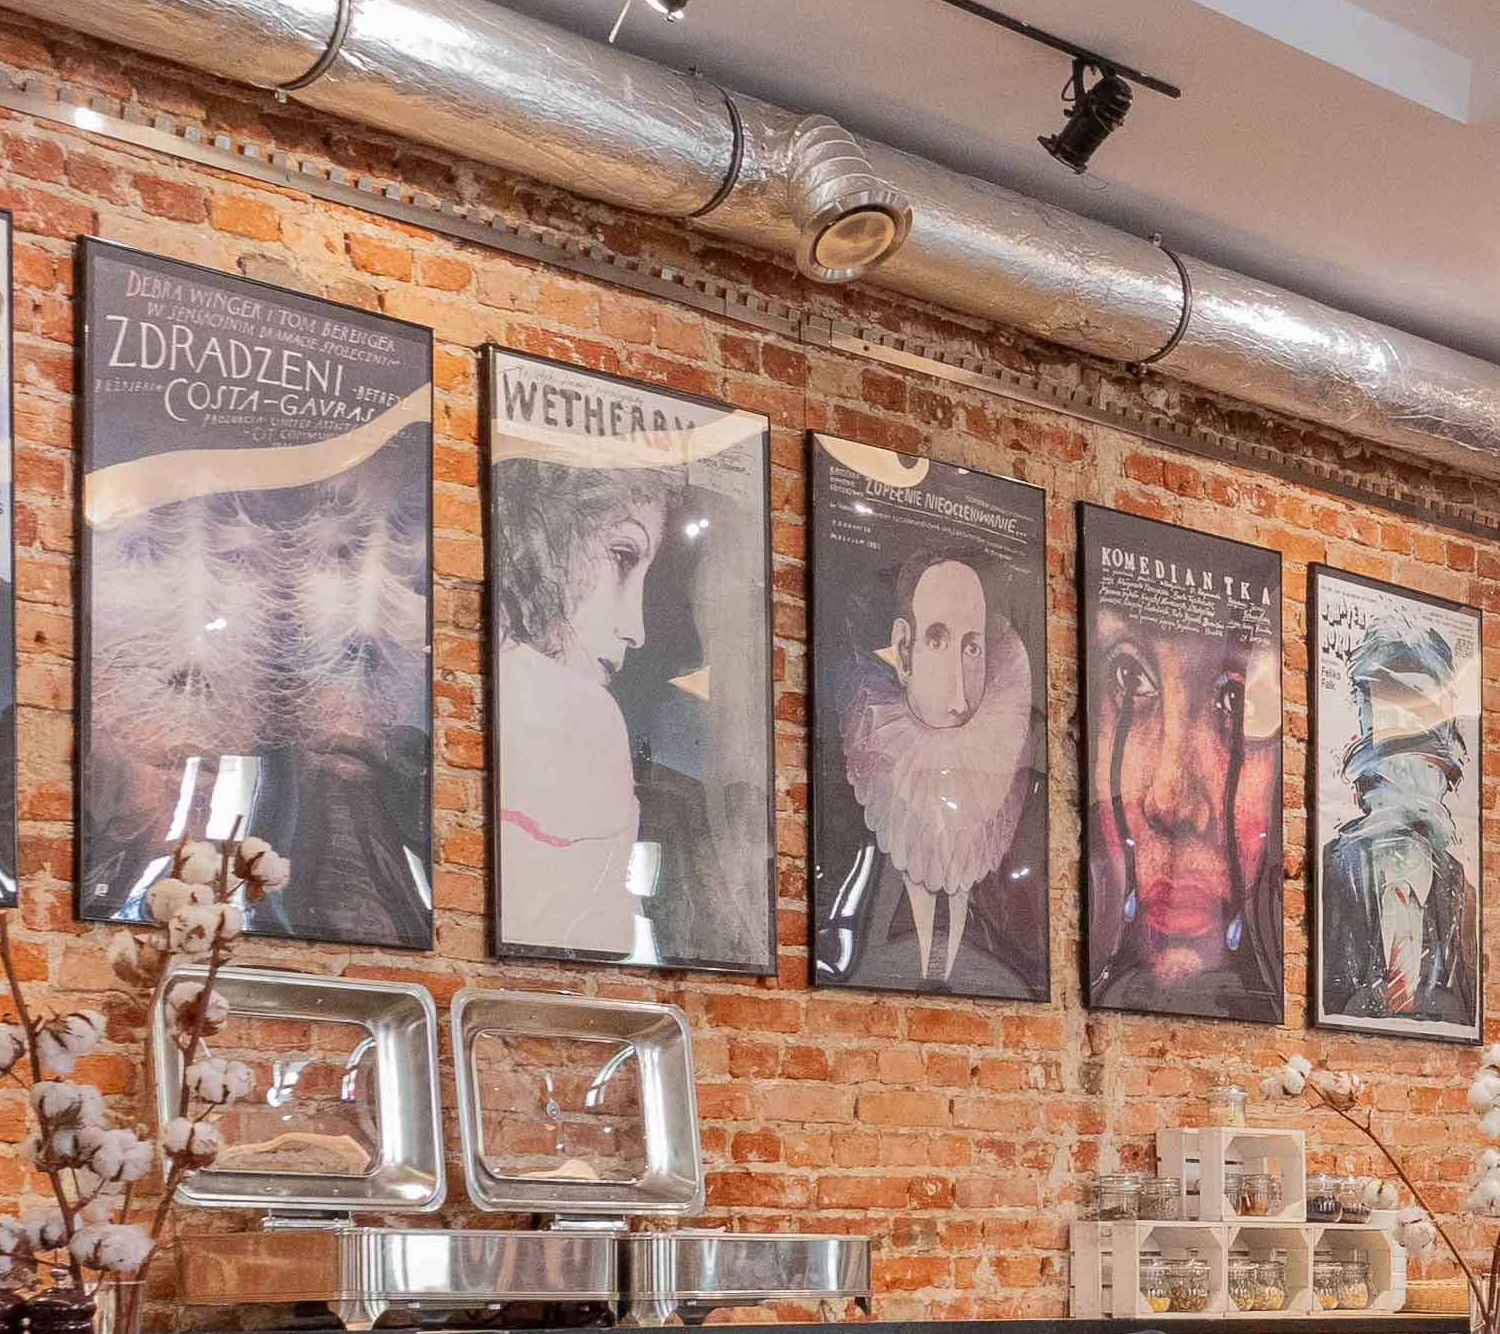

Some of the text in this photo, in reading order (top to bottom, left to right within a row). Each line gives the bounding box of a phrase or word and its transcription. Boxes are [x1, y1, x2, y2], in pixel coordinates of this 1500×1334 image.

[126, 269, 183, 303] DEBRA
[190, 288, 261, 319] WINGER
[277, 309, 318, 335] TOM
[321, 321, 397, 354] BERENGER
[147, 301, 166, 318] W
[106, 314, 344, 397] ZDRADZENI
[164, 377, 376, 423] COSTA-GAVRAS
[503, 372, 695, 460] WETHERBY
